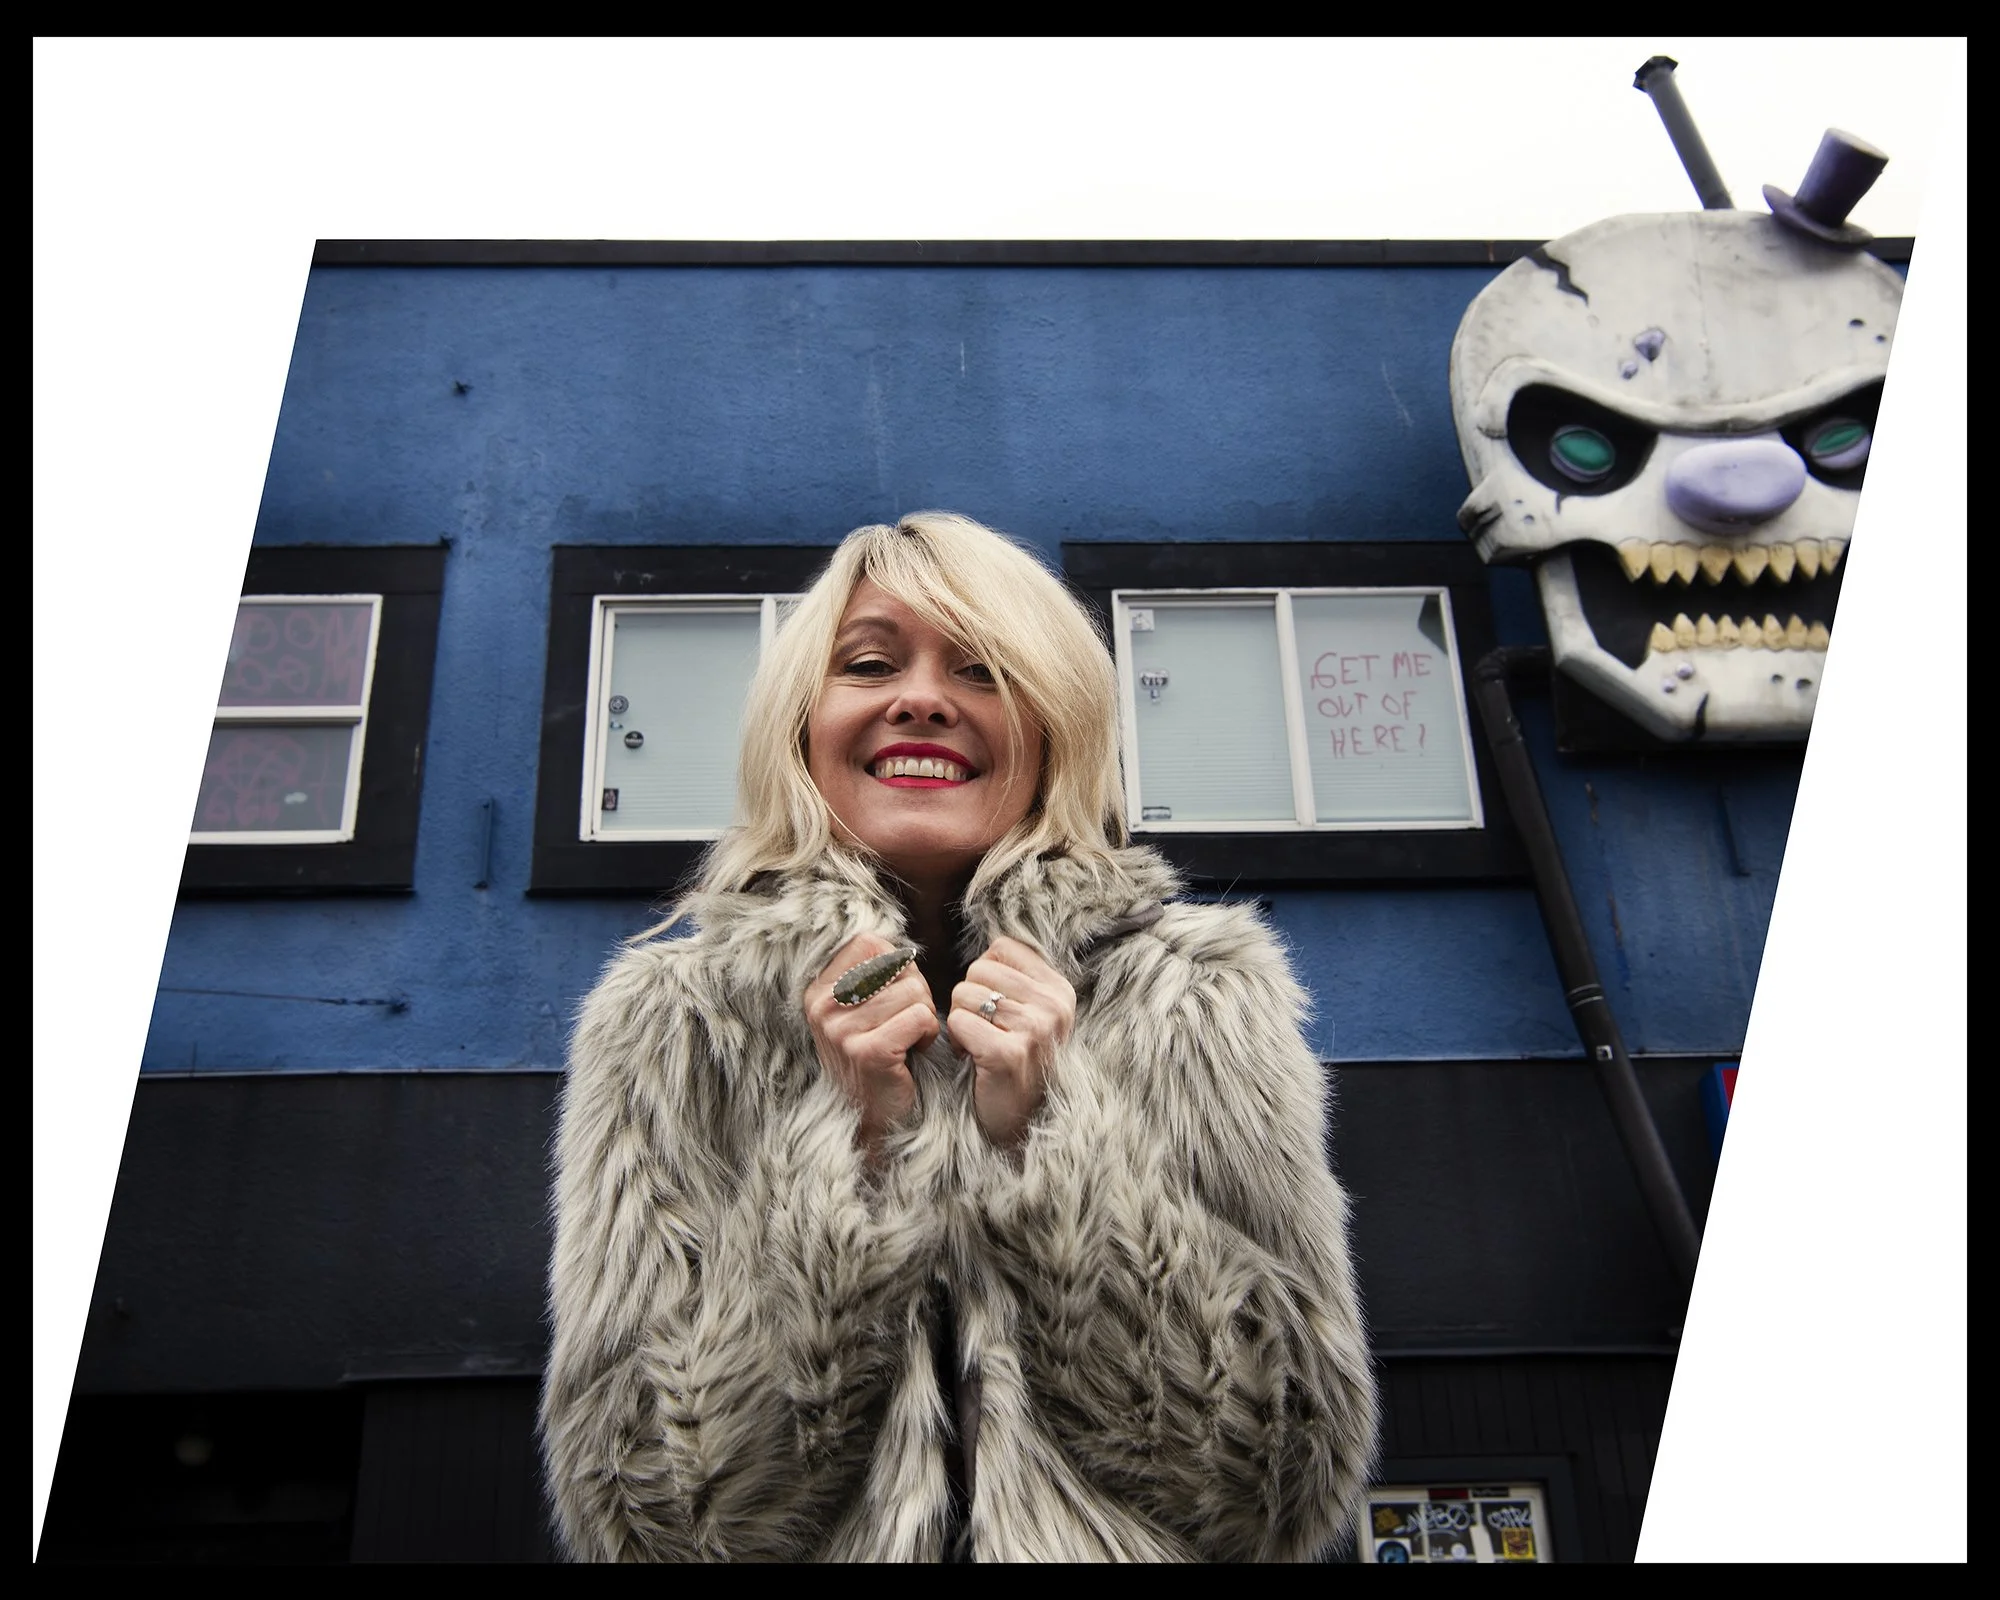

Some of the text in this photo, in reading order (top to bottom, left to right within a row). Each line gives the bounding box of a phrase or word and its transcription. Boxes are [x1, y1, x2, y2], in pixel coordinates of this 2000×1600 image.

[1310, 651, 1432, 690] GET ME
[1317, 690, 1417, 720] OUT OF
